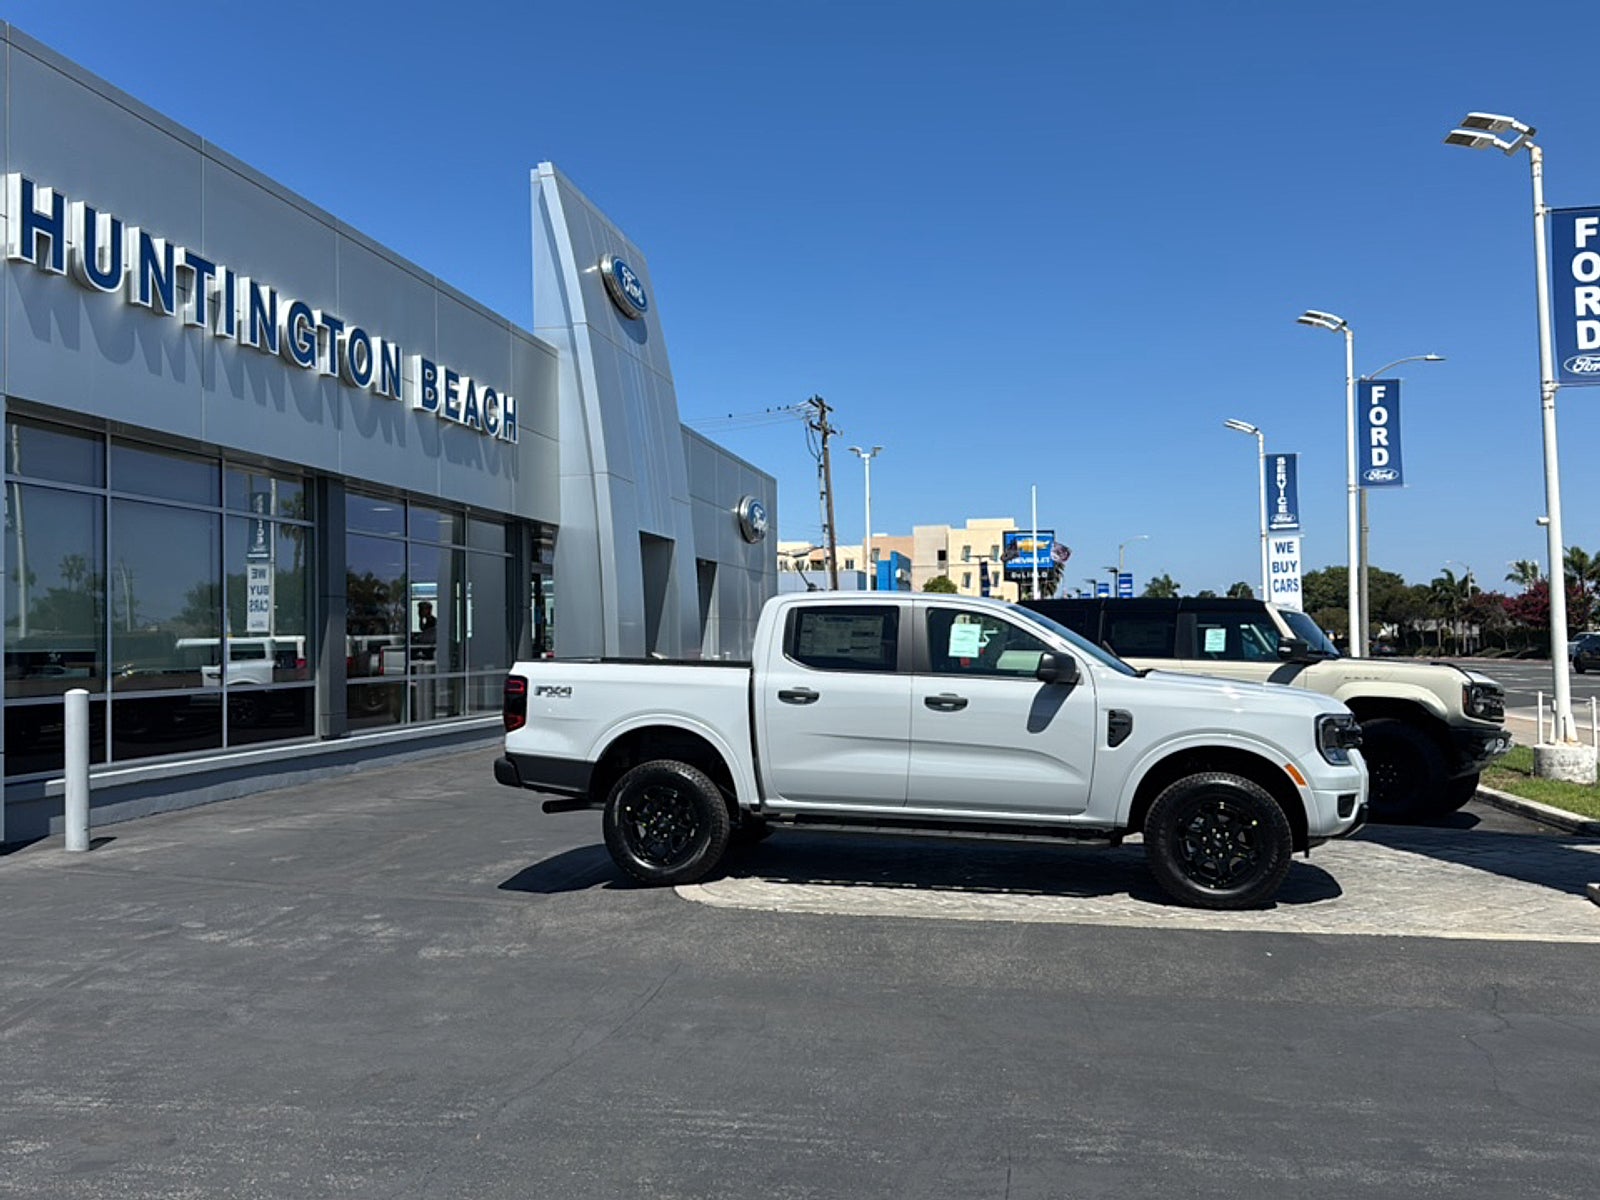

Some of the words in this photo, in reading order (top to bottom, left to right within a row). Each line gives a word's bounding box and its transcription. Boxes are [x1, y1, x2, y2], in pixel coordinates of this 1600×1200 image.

[621, 265, 645, 305] Ford
[1571, 217, 1600, 350] FORD
[7, 173, 402, 400] HUNTINGTON
[412, 355, 519, 444] BEACH
[1573, 356, 1600, 372] For
[1369, 386, 1389, 467] FORD
[1368, 469, 1394, 481] Ford
[1276, 456, 1288, 513] SERVICE
[1275, 541, 1294, 553] WE
[1272, 561, 1297, 573] BUY
[1273, 578, 1299, 593] CARS
[534, 685, 572, 696] FX4
